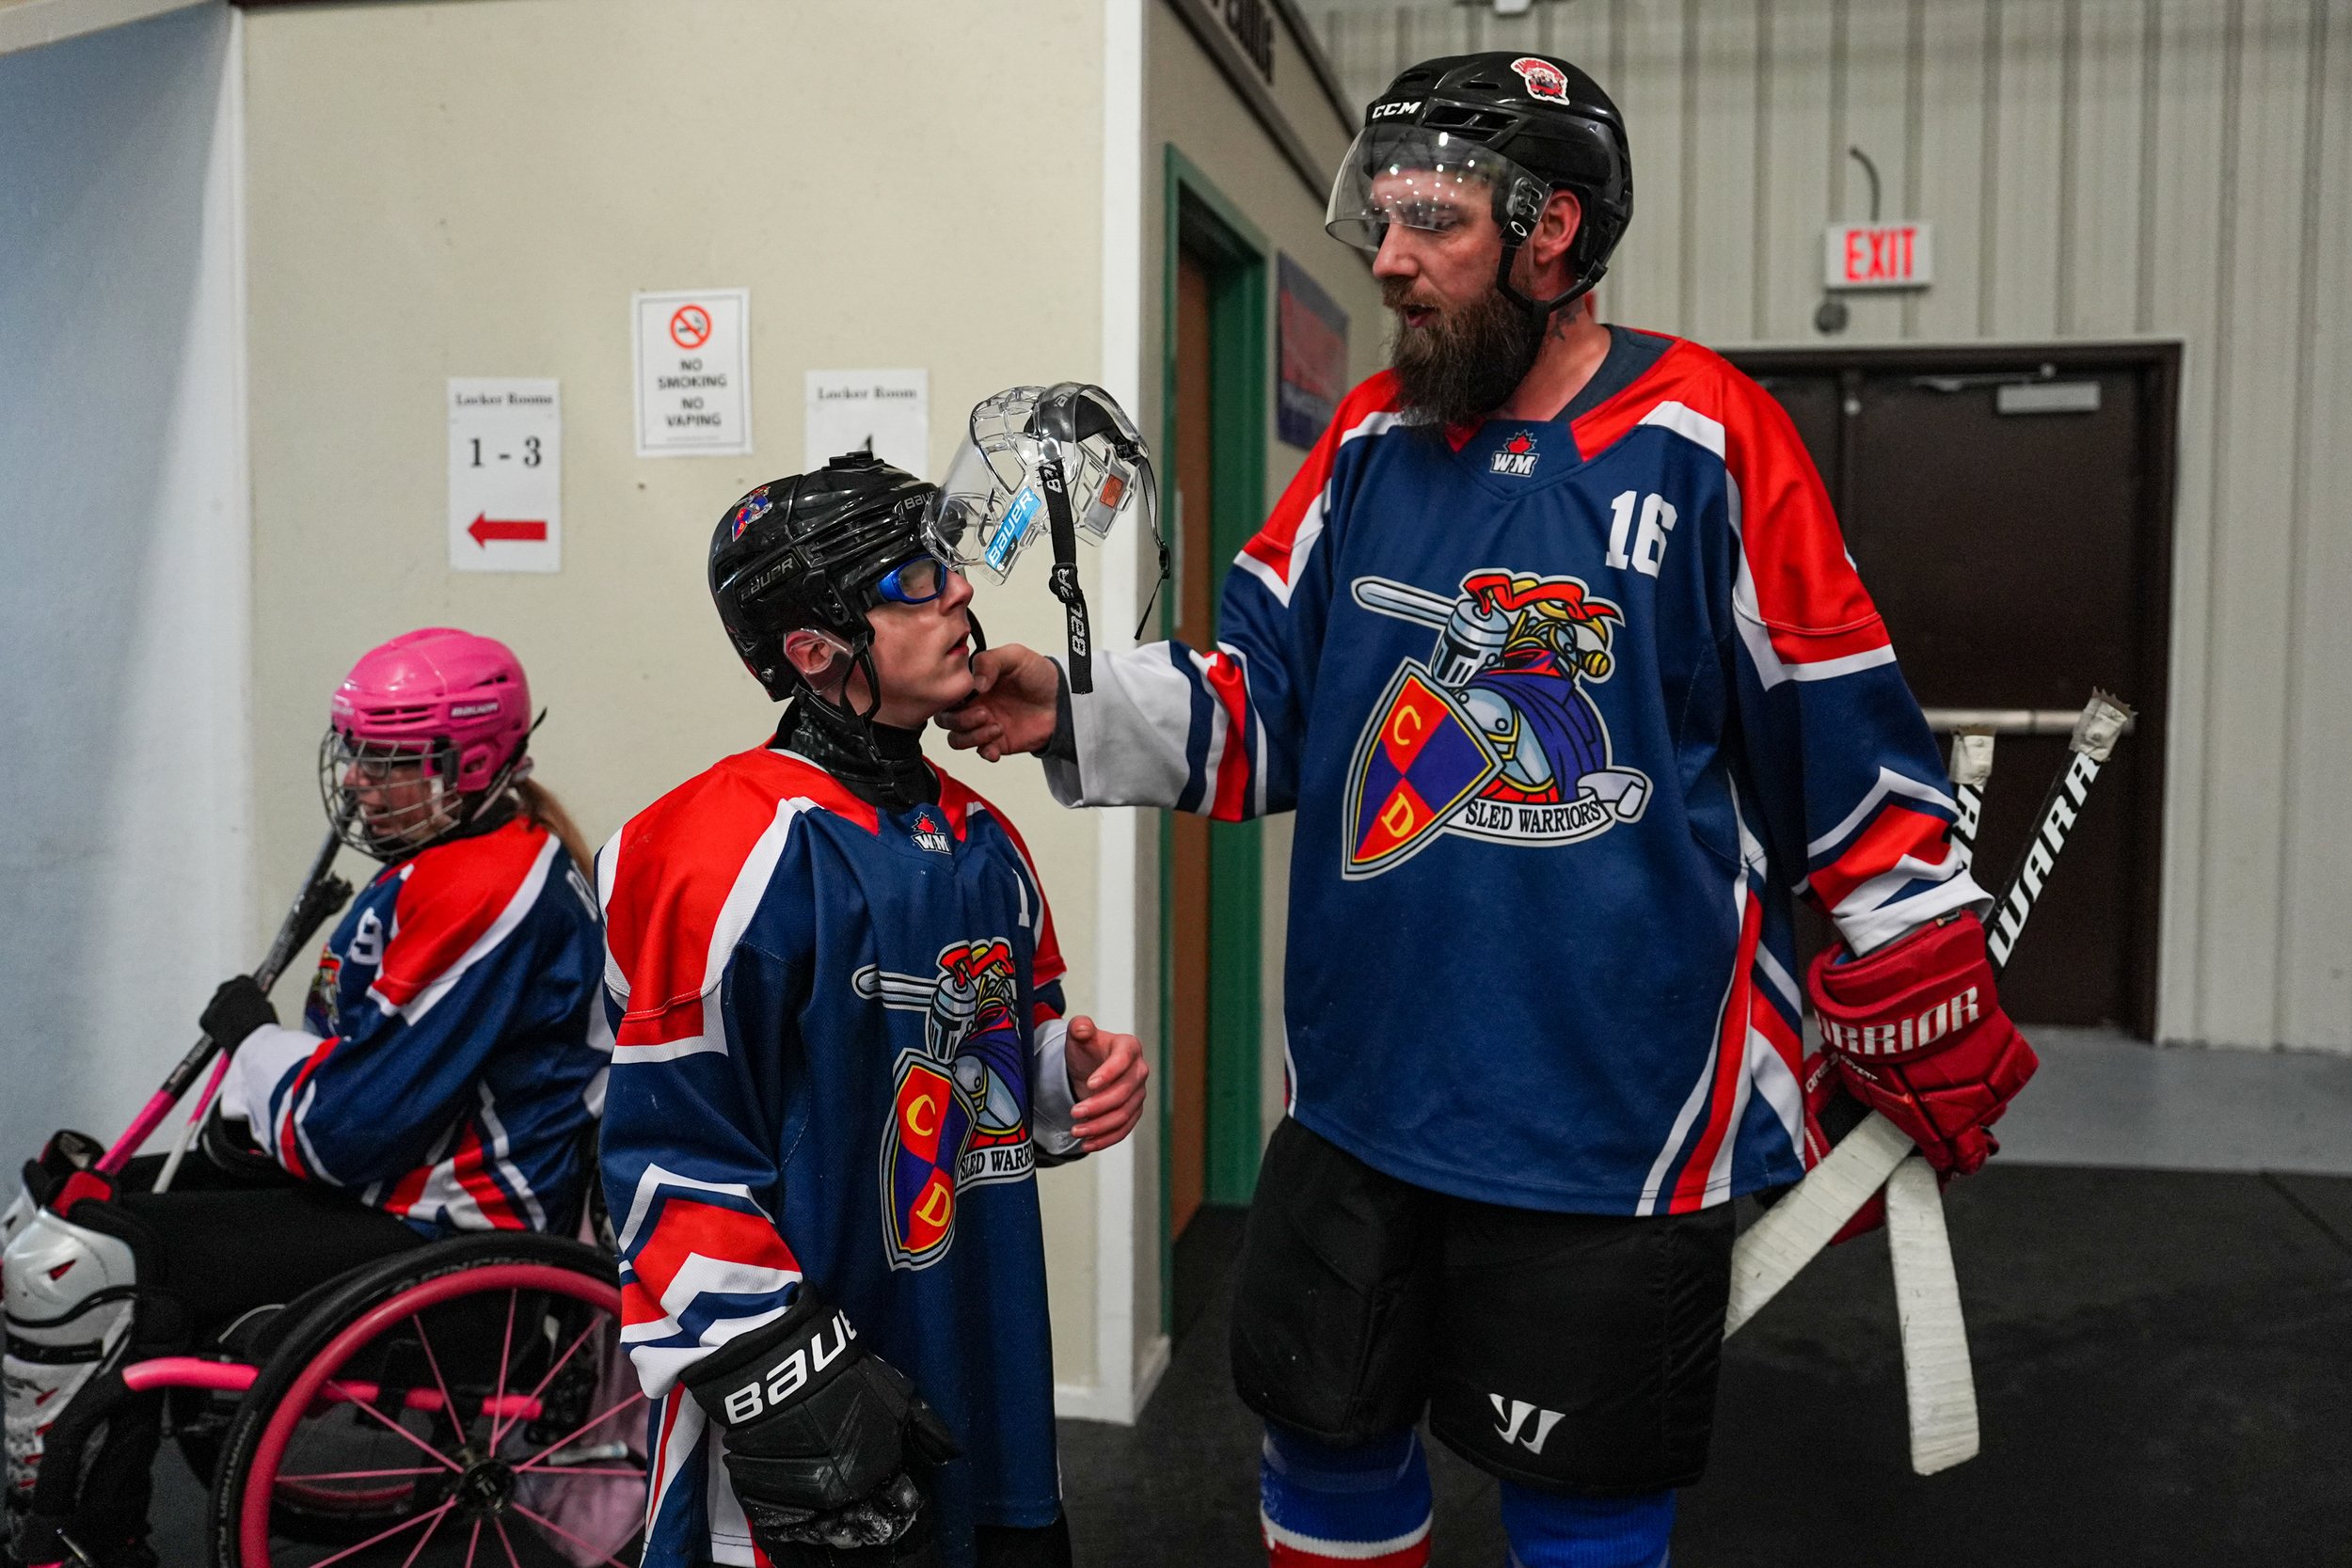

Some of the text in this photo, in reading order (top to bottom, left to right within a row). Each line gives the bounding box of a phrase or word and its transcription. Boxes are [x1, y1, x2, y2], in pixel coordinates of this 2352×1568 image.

[1372, 101, 1422, 119] CCM
[1845, 227, 1915, 282] EXIT
[679, 358, 703, 372] NO
[455, 391, 553, 406] Locker Rooms
[658, 374, 728, 391] SMOKING
[817, 385, 917, 400] Locker Room
[681, 397, 705, 410] NO
[666, 413, 723, 428] VAPING
[469, 436, 483, 468] 1
[524, 436, 542, 468] 3
[1492, 452, 1536, 475] WM
[1605, 490, 1678, 579] 16
[1393, 705, 1422, 746] C
[1381, 792, 1414, 838] D
[1465, 800, 1601, 833] SLED WARRIORS
[914, 833, 950, 852] WM
[1987, 751, 2101, 968] WARR
[906, 1094, 936, 1136] C
[960, 1143, 1033, 1181] SLED WARRI
[915, 1182, 951, 1227] D
[723, 1308, 858, 1425] BAUE
